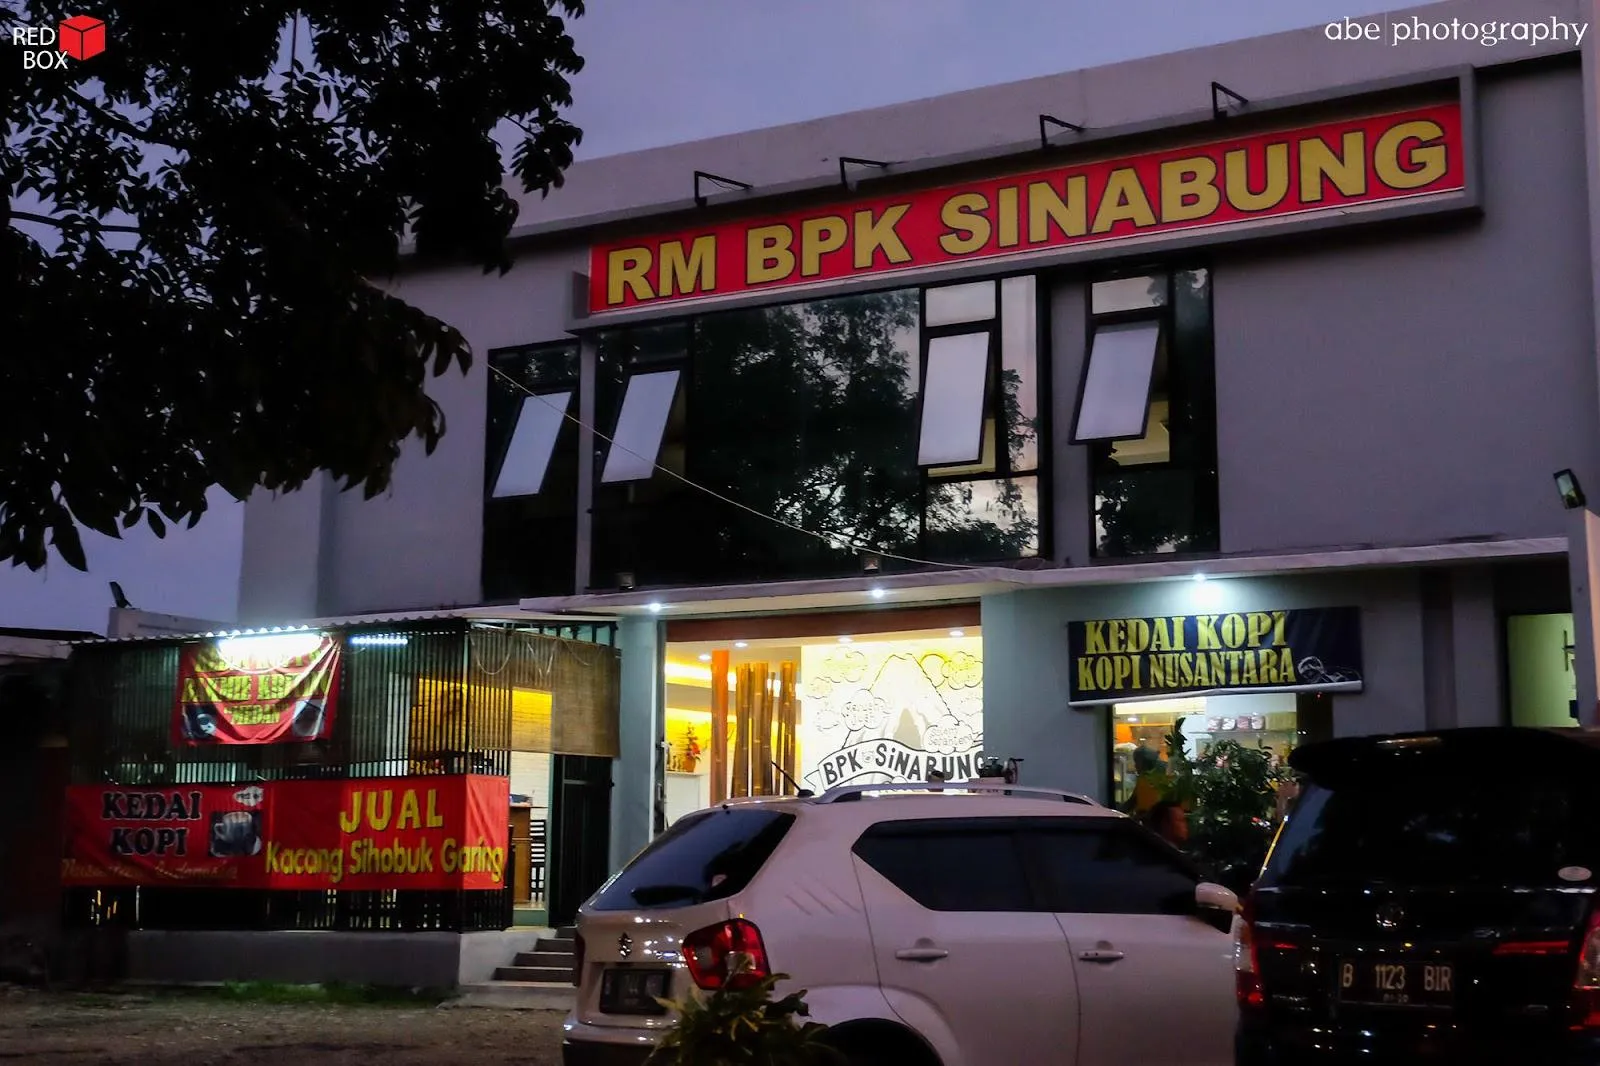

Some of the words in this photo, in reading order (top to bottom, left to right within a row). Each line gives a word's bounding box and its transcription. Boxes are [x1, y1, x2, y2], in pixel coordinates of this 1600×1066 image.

[607, 234, 716, 305] RM
[745, 203, 913, 285] BPK
[938, 119, 1448, 256] SINABUNG
[1084, 615, 1186, 654] KEDAI
[1195, 611, 1288, 650] KOPI
[1077, 654, 1141, 691] KOPI
[1149, 647, 1297, 689] NUSANTARA
[823, 748, 863, 786] BPK
[101, 790, 203, 821] KEDAI
[339, 788, 443, 834] JUAL
[111, 826, 190, 857] KOPI
[350, 836, 433, 874] Sihobuk
[440, 836, 504, 883] Garing
[1342, 963, 1354, 988] B
[1375, 964, 1406, 990] 1123
[1424, 965, 1452, 992] BIR
